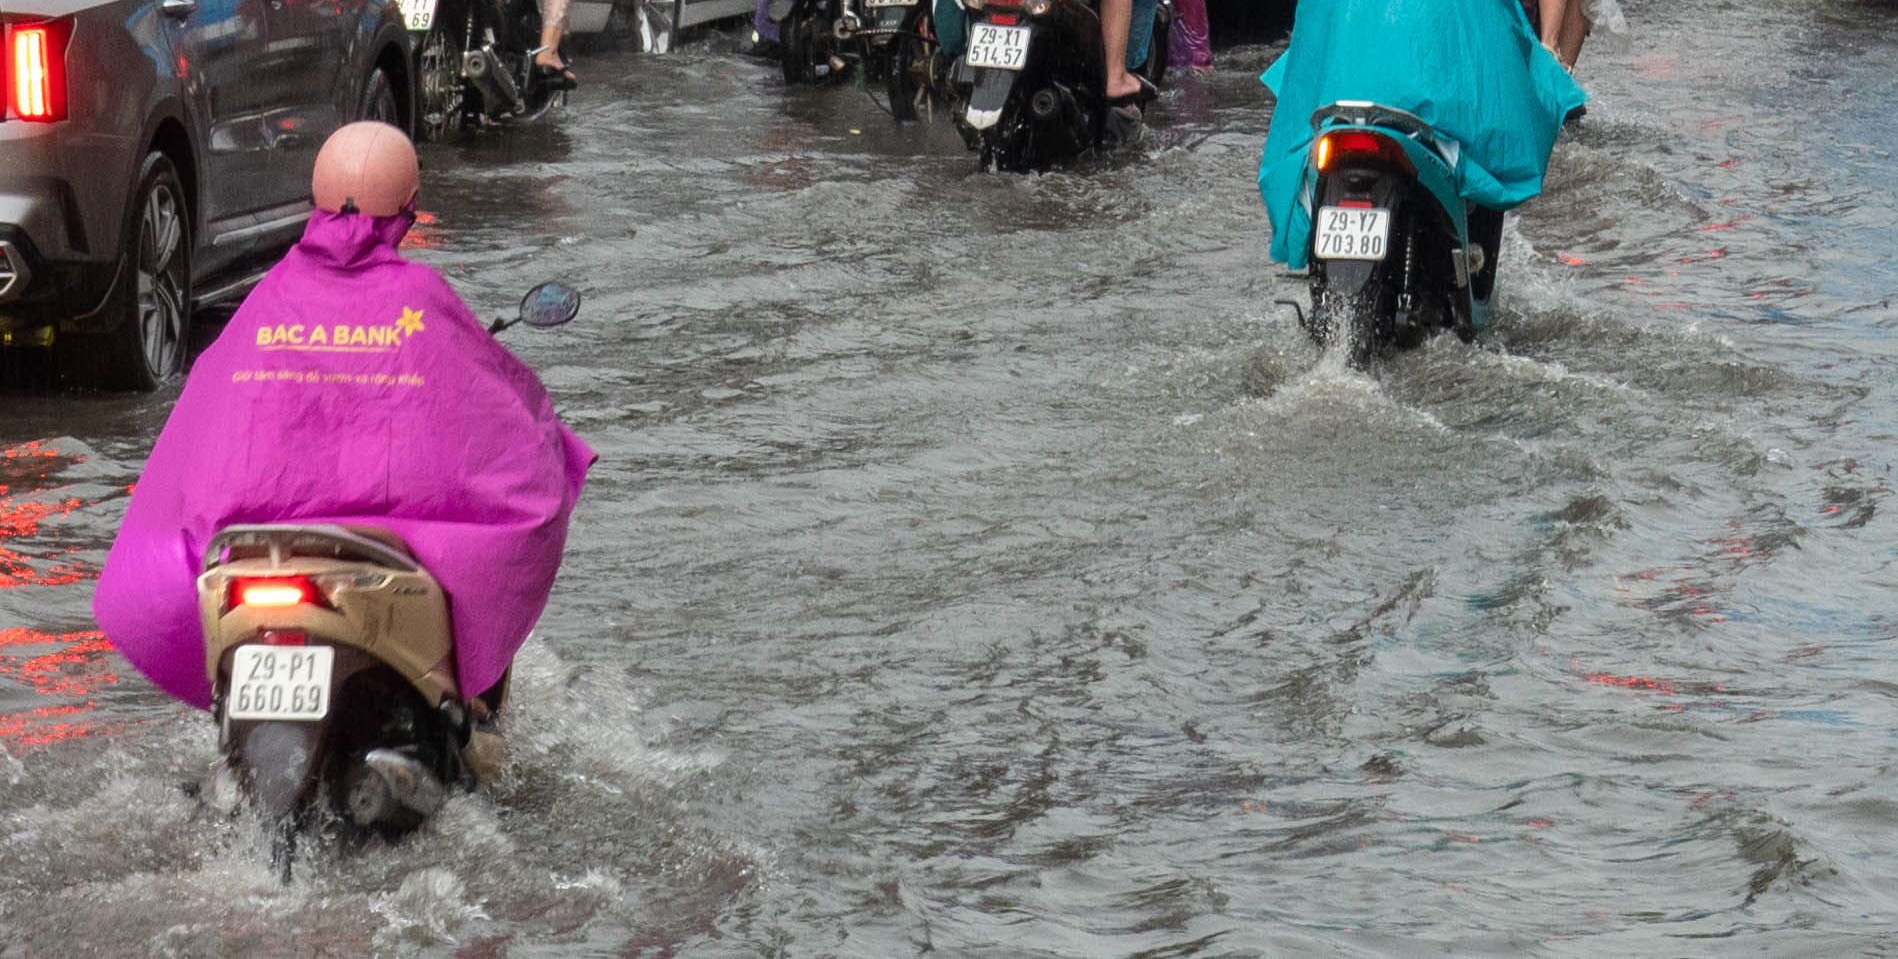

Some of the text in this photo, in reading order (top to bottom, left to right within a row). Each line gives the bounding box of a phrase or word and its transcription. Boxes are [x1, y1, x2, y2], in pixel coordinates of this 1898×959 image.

[979, 27, 1021, 47] 29-X1
[971, 46, 1023, 66] 514.57
[1328, 211, 1378, 232] 29-Y7
[1321, 234, 1382, 255] 703.80
[256, 324, 402, 347] BAC A BANK
[248, 651, 317, 682] 29-P1
[237, 684, 322, 714] 660.69
